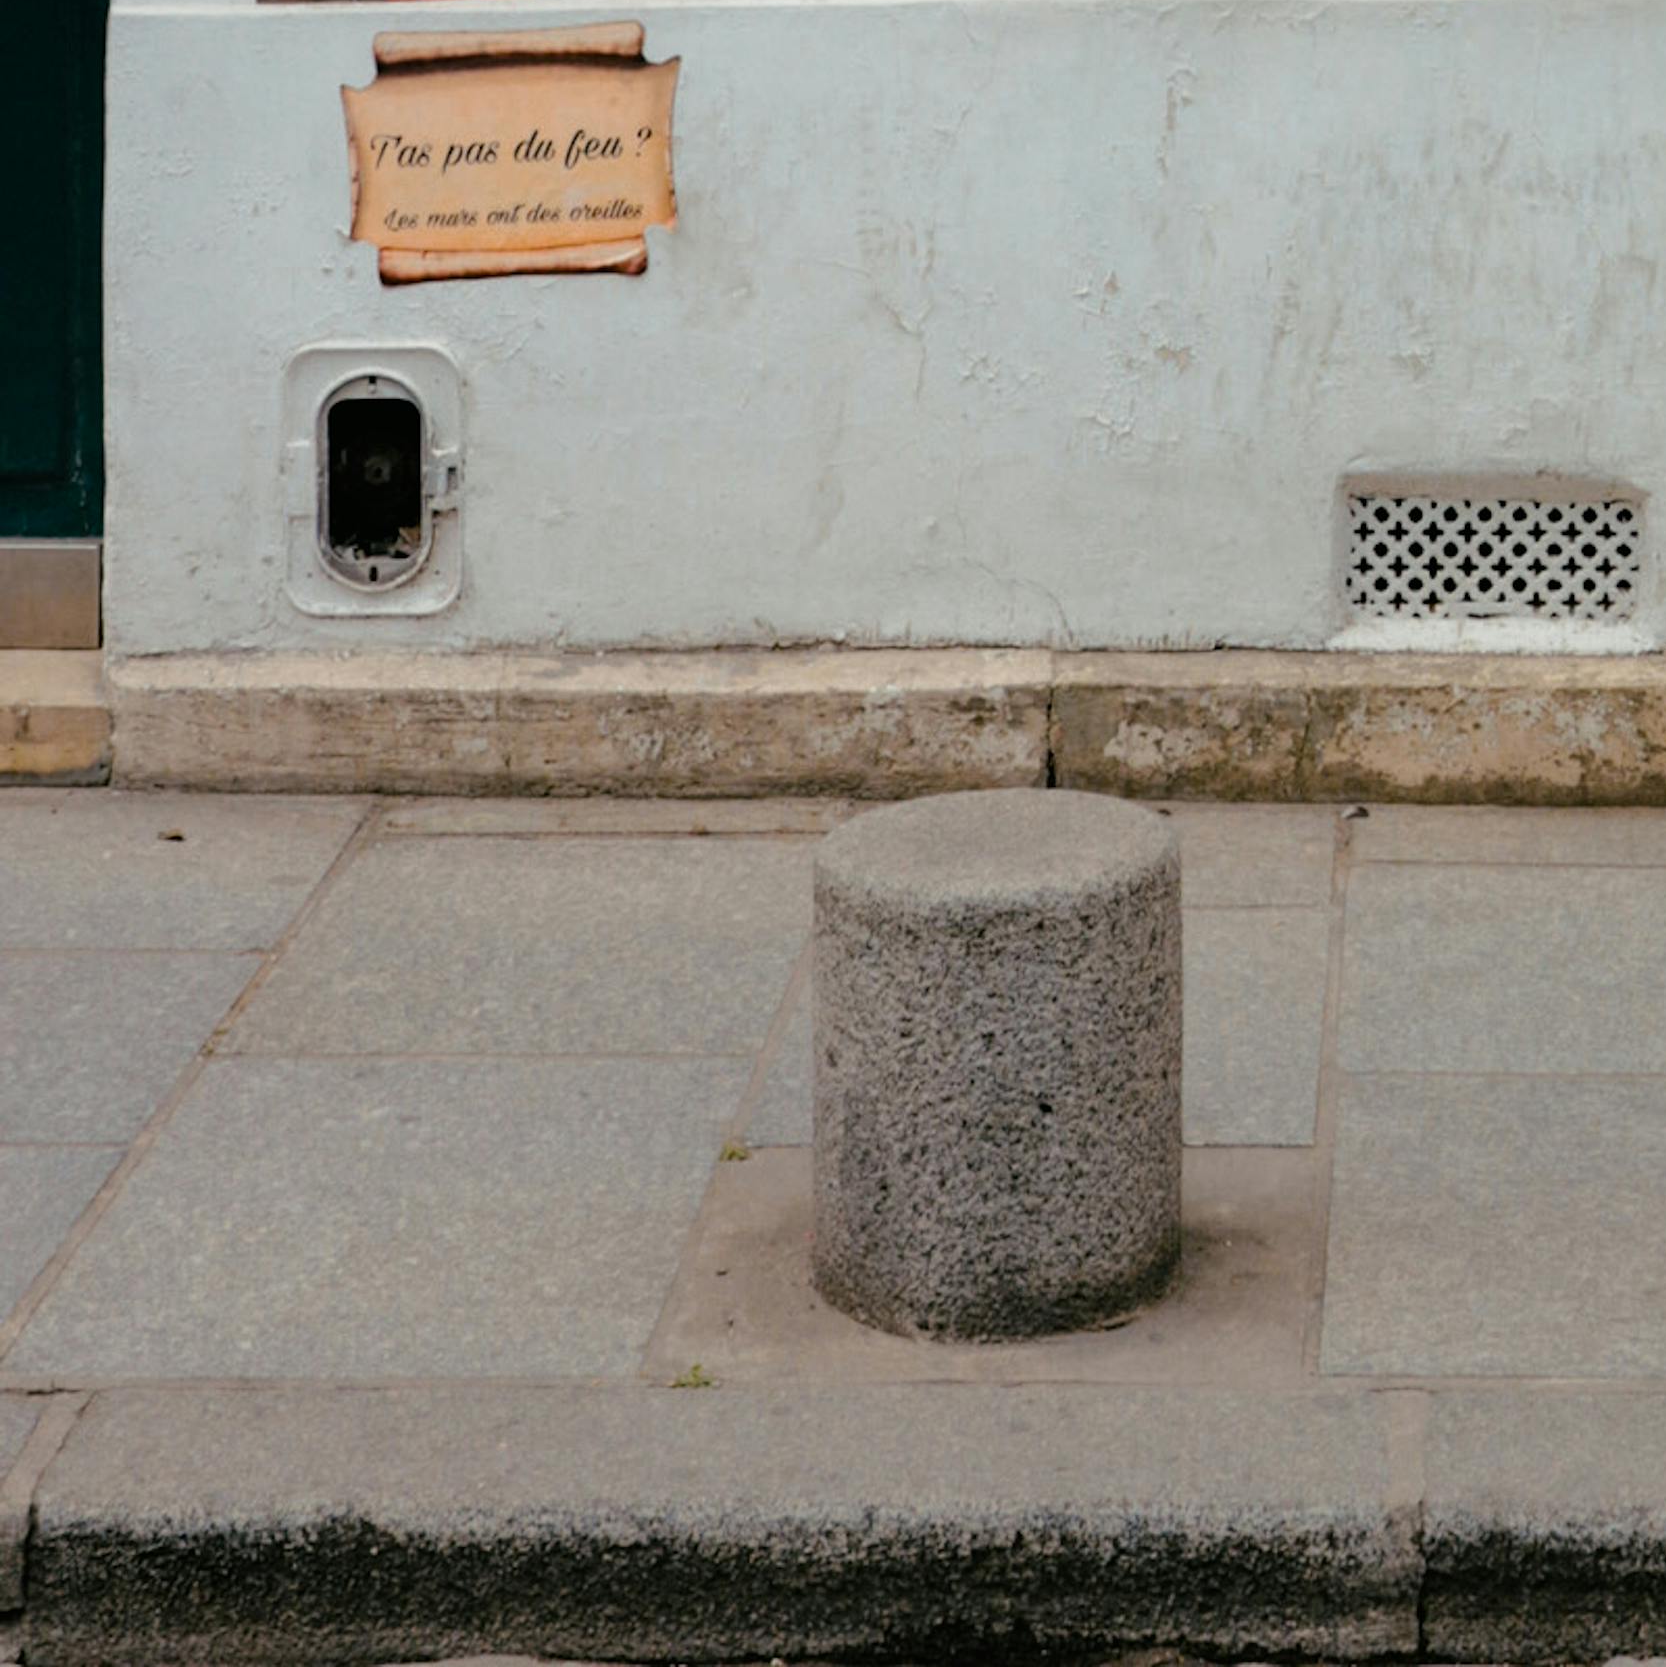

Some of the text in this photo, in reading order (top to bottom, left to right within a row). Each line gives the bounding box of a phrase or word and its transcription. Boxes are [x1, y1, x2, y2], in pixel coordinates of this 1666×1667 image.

[370, 128, 653, 175] T'as pas du feu ?
[384, 198, 643, 232] Les murs ont des oreilles
